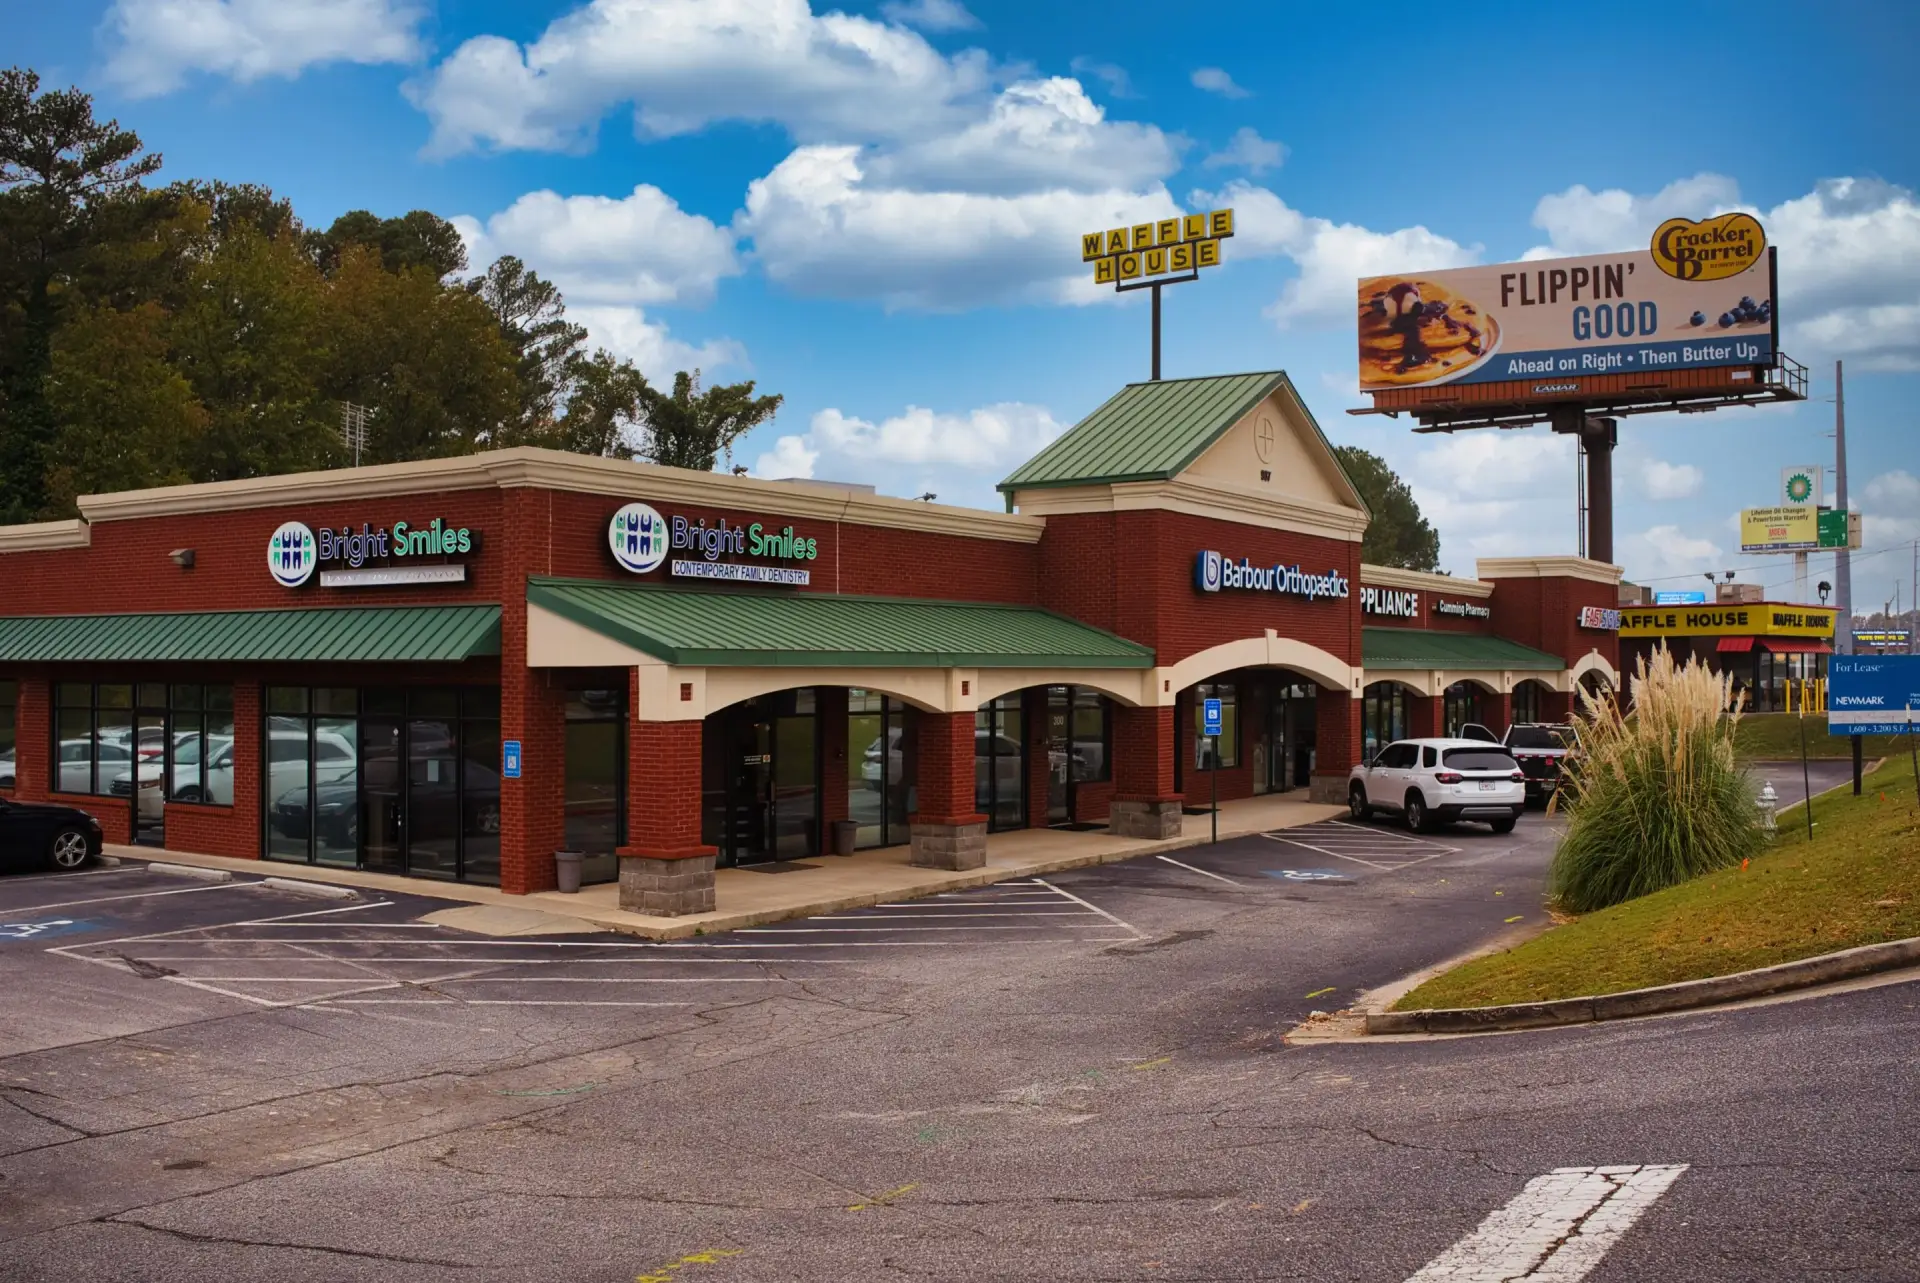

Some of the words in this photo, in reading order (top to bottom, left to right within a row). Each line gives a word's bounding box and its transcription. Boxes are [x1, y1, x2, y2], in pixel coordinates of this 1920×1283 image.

[1084, 213, 1226, 254] WAFFLE
[1659, 226, 1751, 262] Cracker
[1098, 243, 1213, 279] HOUSE
[1677, 240, 1753, 280] Barrel
[1501, 263, 1635, 307] FLIPPIN'
[1573, 301, 1657, 340] GOOD
[1508, 357, 1554, 374] Ahead
[1559, 359, 1577, 370] on
[1582, 353, 1622, 371] Right
[1639, 349, 1676, 365] Then
[1683, 344, 1731, 362] Butter
[1736, 342, 1758, 360] Up
[1535, 384, 1577, 392] LAMAR
[1751, 508, 1772, 516] Lifetime
[319, 523, 388, 568] Bright
[393, 517, 471, 556] Smiles
[672, 515, 745, 560] Bright
[749, 523, 817, 560] Smiles
[674, 561, 740, 578] CONTEMPORARY
[741, 566, 769, 581] FAMILY
[768, 569, 808, 584] DENTISTRY
[1223, 558, 1274, 591] Barbour
[1276, 564, 1349, 600] Orthopaedics
[1360, 588, 1418, 617] PPLIANCE
[1440, 600, 1465, 616] Cumming
[1465, 602, 1490, 618] Pharmacy
[1620, 614, 1676, 628] AFFLE
[1686, 612, 1748, 627] HOUSE
[1773, 613, 1803, 627] WAFFLE
[1806, 615, 1830, 628] HOUSE
[1835, 662, 1851, 672] For
[1854, 662, 1881, 672] Lease
[1835, 696, 1884, 705] NEWMARK
[1053, 715, 1064, 726] 300
[1849, 725, 1866, 733] 1,600
